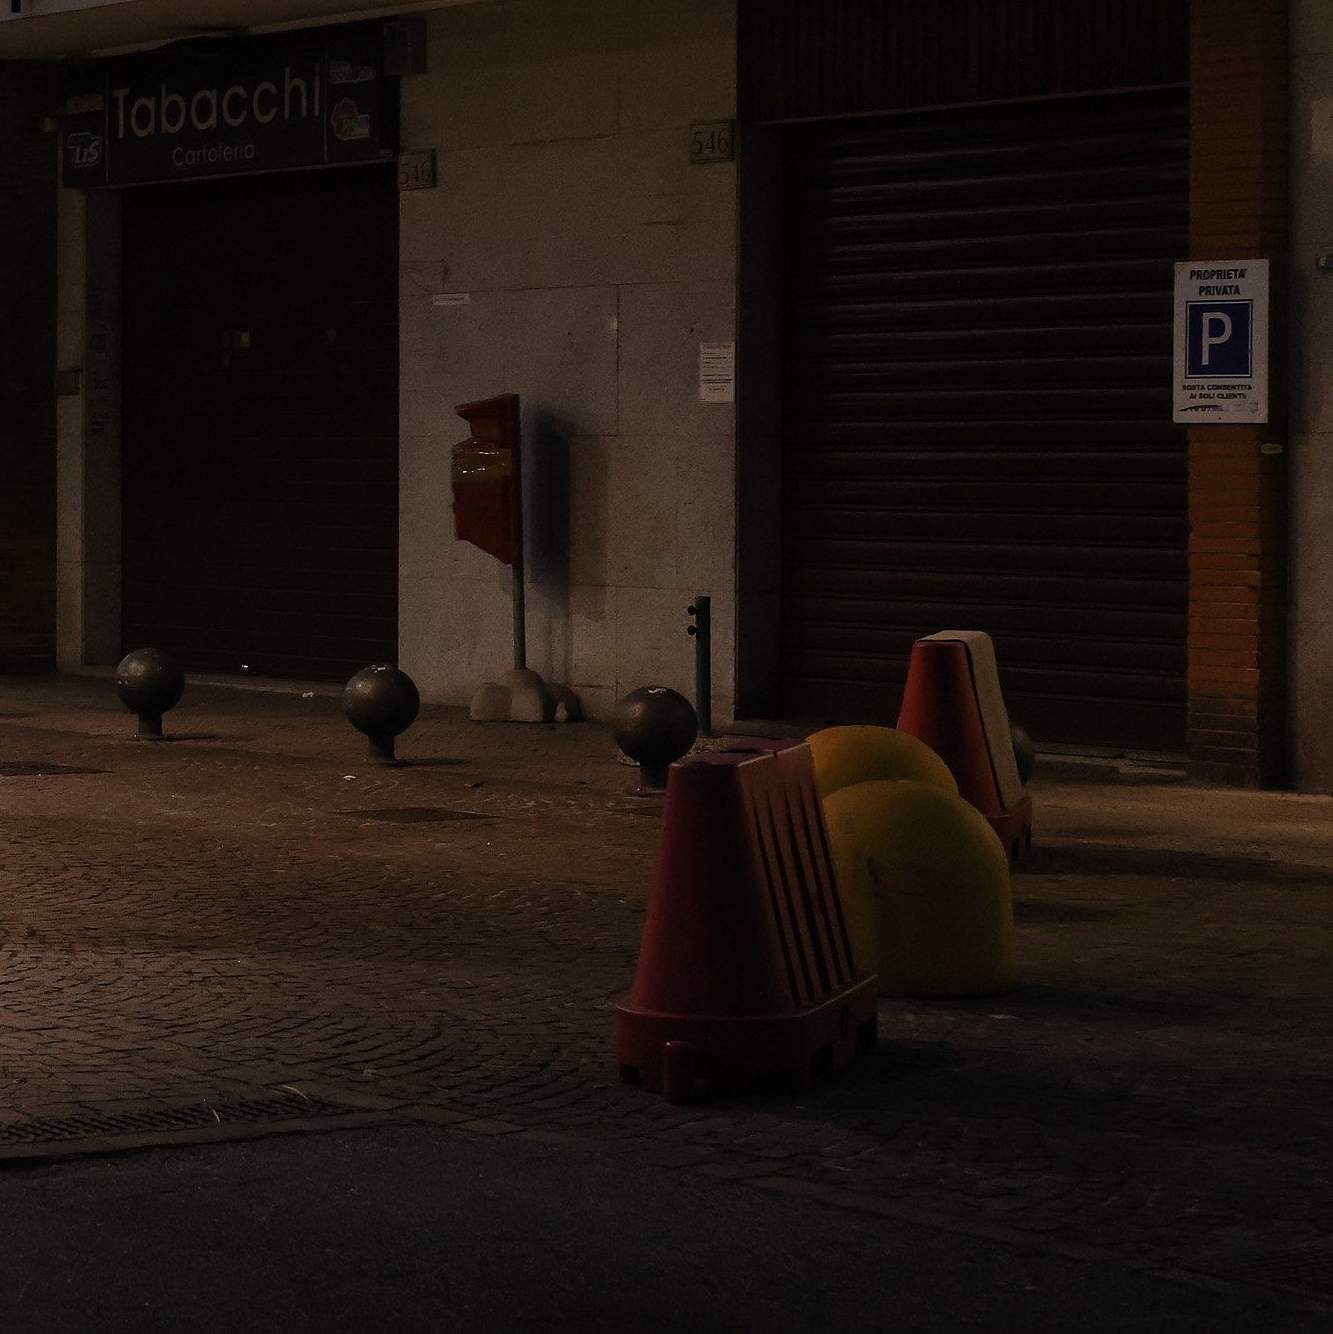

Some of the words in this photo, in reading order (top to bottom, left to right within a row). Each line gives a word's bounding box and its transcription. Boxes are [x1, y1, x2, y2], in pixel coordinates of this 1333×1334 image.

[112, 63, 320, 139] Tabacchi
[1199, 285, 1240, 296] PRIVATA
[1201, 312, 1232, 365] P
